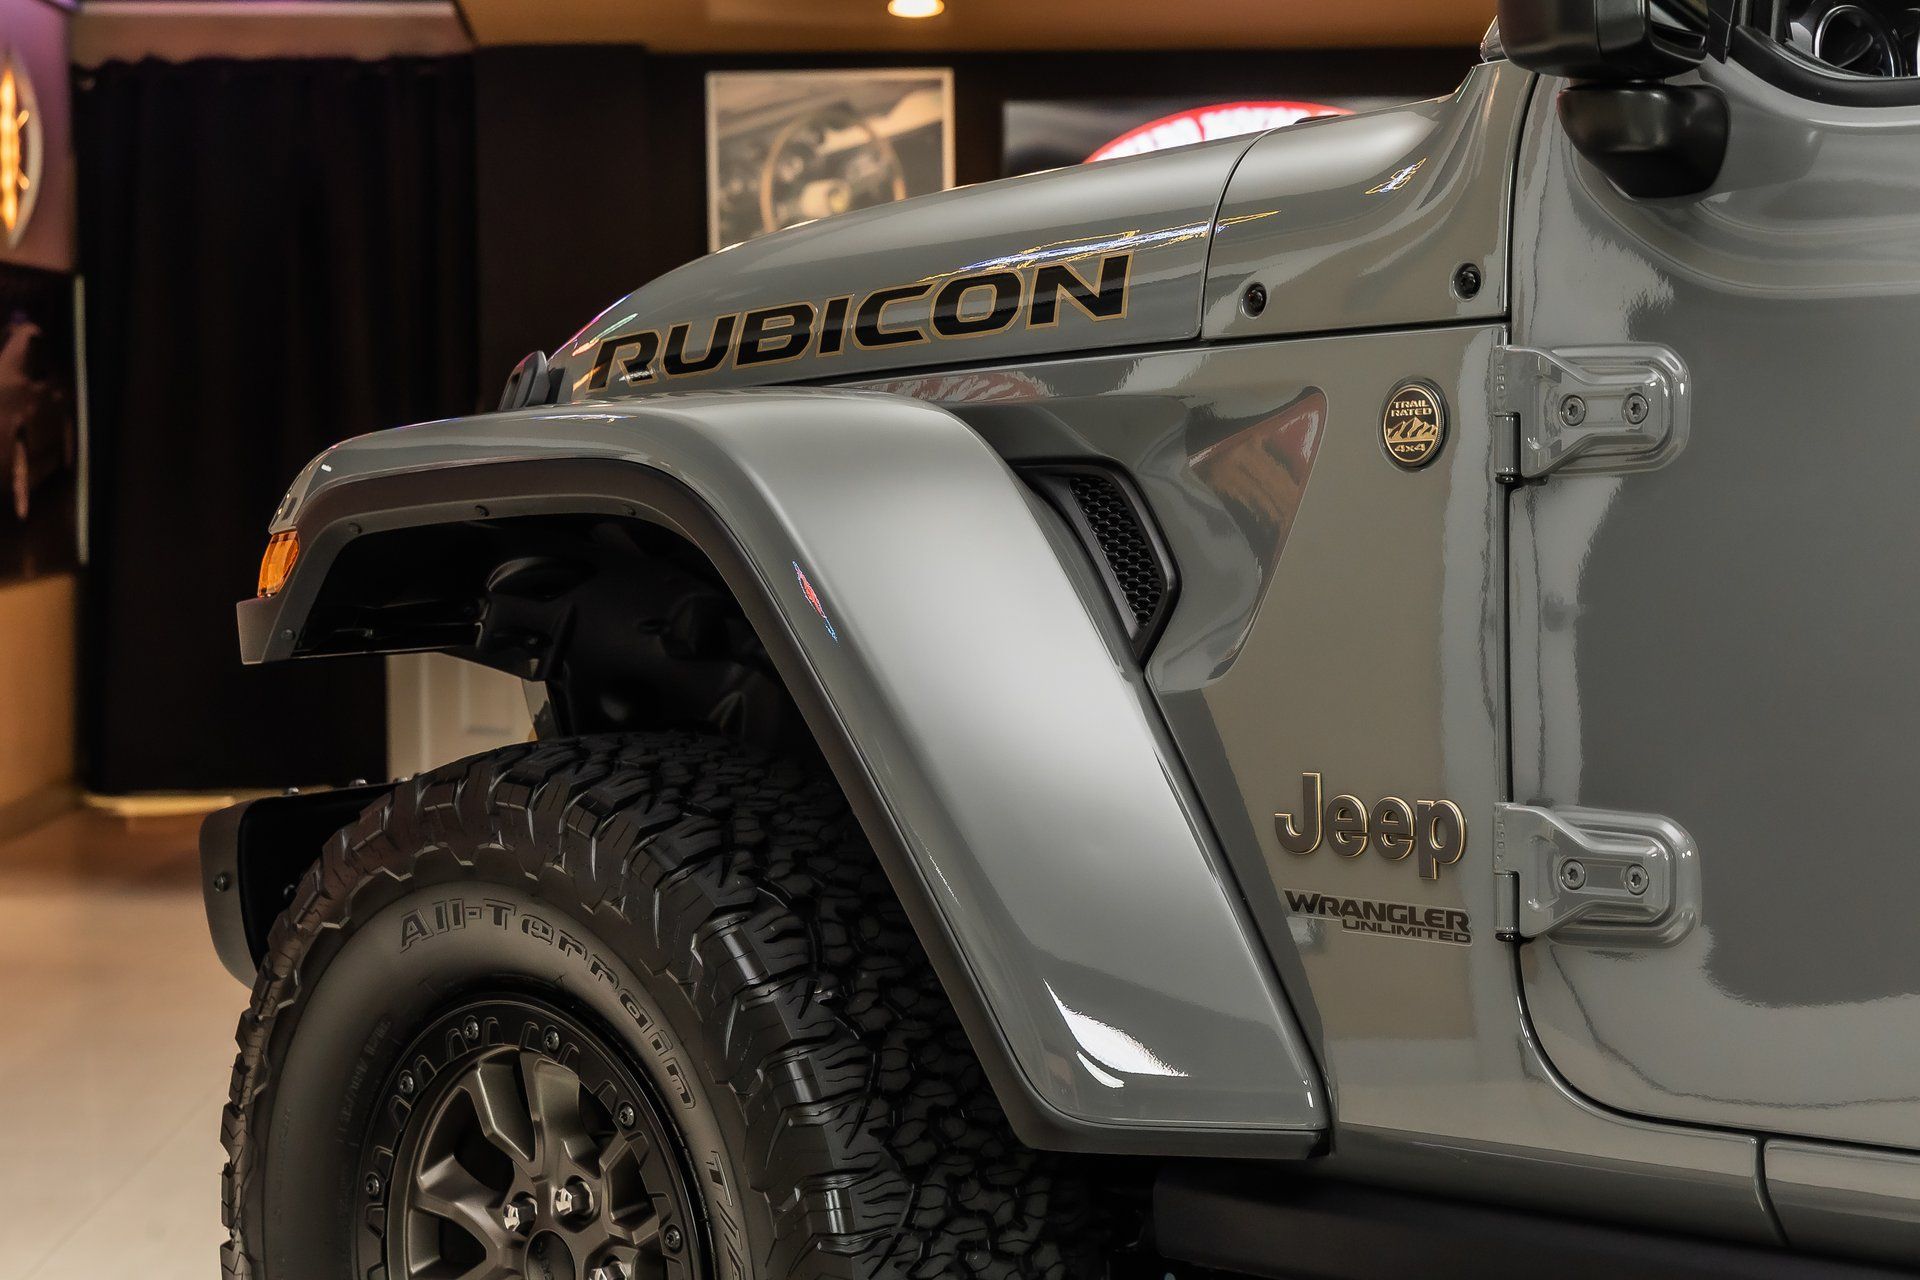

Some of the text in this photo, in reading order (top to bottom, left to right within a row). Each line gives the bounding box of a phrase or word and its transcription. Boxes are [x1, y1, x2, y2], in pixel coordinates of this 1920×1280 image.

[585, 250, 1135, 392] RUBICON
[1391, 407, 1432, 417] RATED
[1393, 400, 1429, 409] TRAIL
[1274, 772, 1466, 880] Jeep
[1284, 889, 1471, 933] WRANGLER
[1342, 918, 1472, 944] UNLIMITED
[400, 898, 696, 1109] All-Terrain
